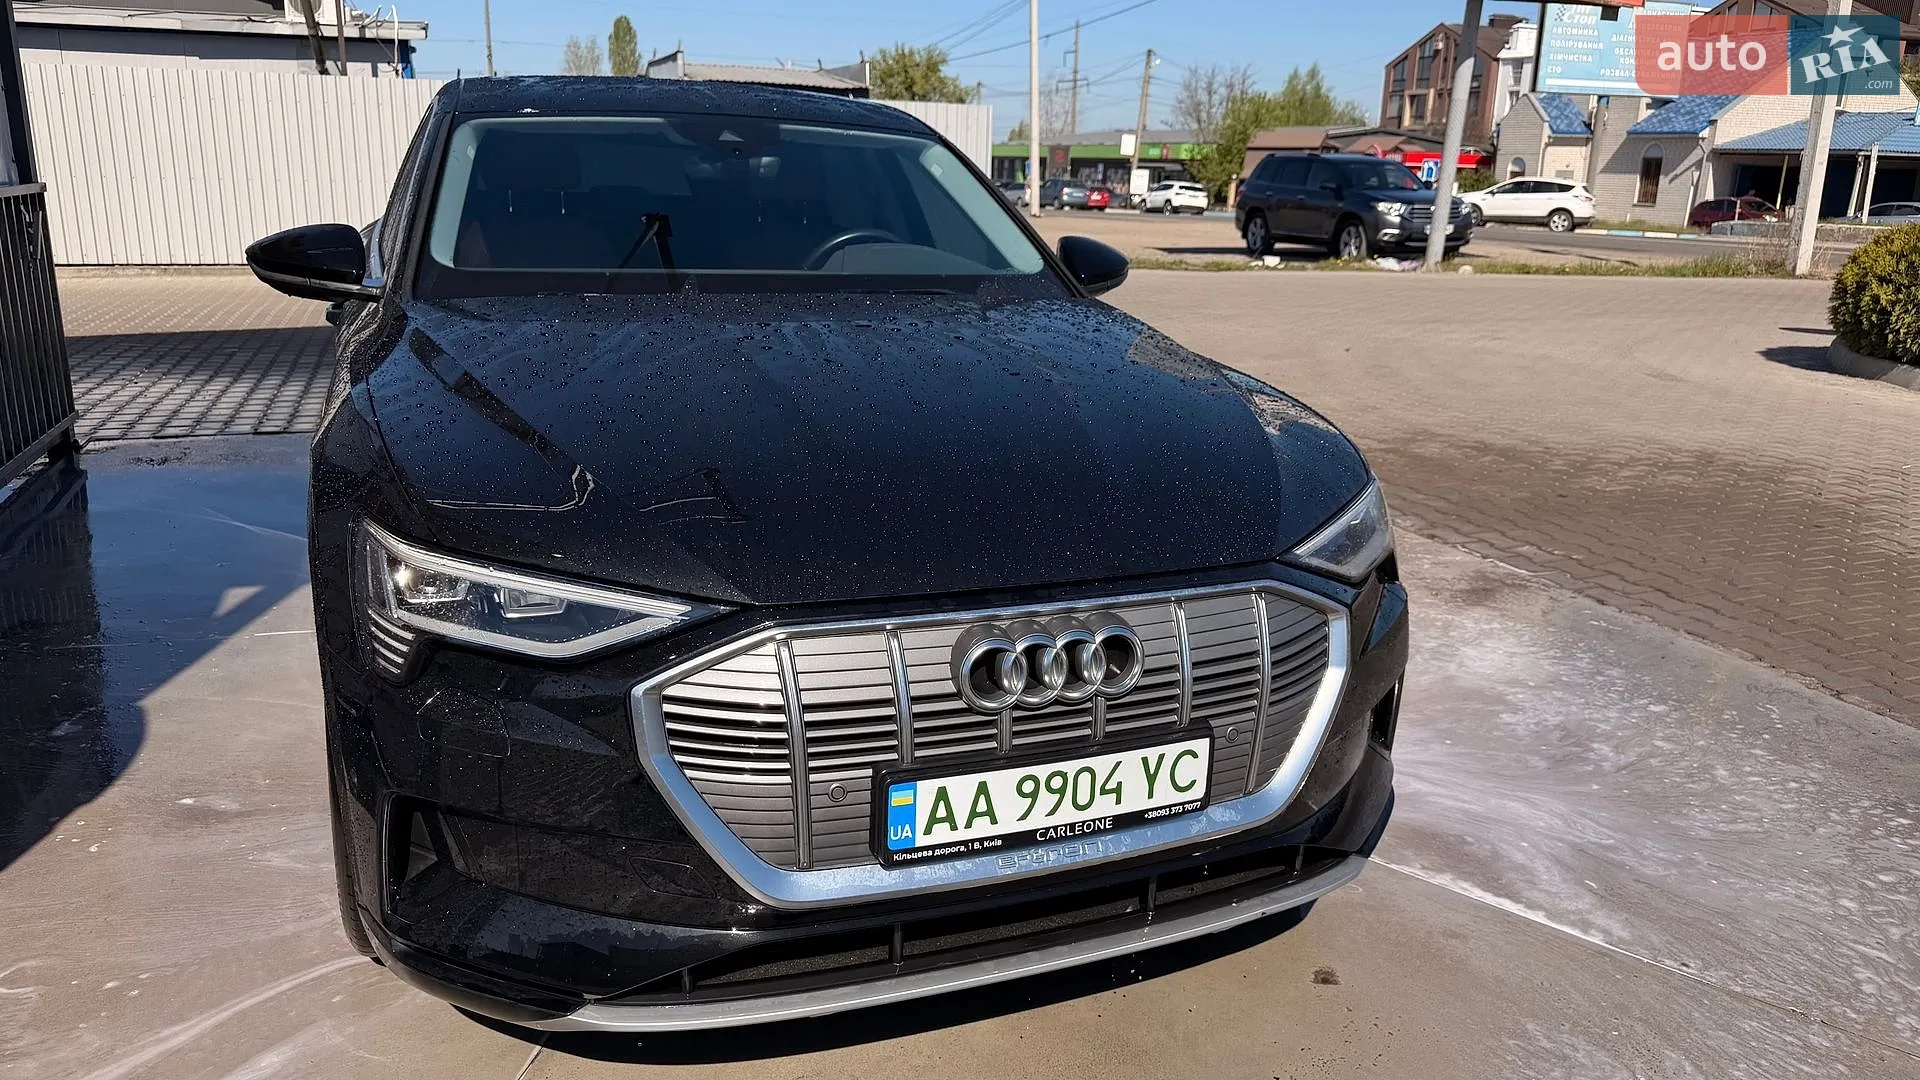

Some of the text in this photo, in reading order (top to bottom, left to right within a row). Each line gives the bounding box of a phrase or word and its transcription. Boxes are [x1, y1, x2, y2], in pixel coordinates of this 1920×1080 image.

[922, 749, 1200, 836] AA 9904 YC
[1170, 804, 1184, 815] 373
[890, 823, 913, 841] UA
[1036, 817, 1114, 841] CARLEONE
[893, 850, 933, 861] Кільцева
[933, 845, 968, 857] дорога,
[983, 838, 1002, 848] Київ
